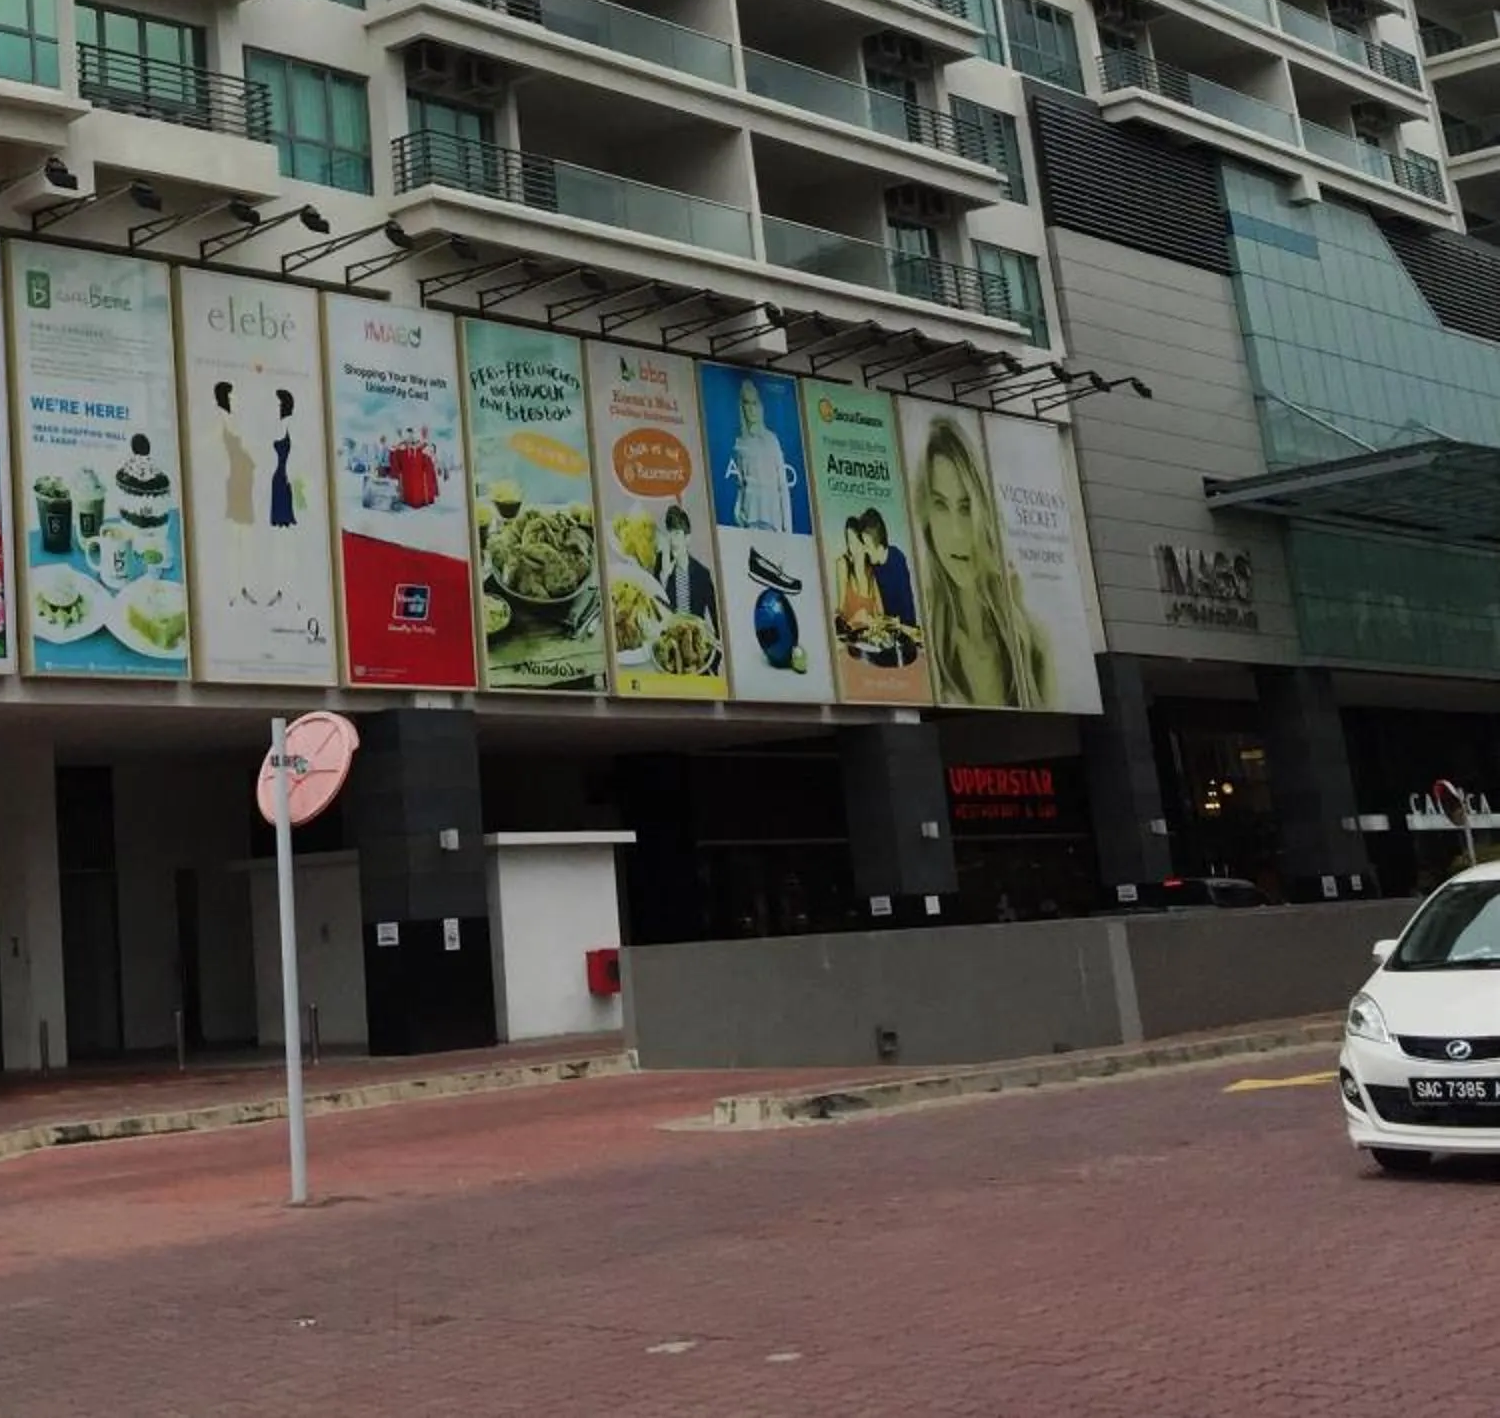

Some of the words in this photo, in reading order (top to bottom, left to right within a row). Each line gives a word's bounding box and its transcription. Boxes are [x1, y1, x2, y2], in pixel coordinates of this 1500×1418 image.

[30, 394, 80, 415] WE'RE
[84, 401, 130, 420] HERE!
[948, 767, 1055, 796] UPPERSTAR
[1415, 1080, 1443, 1098] SAC
[1445, 1080, 1487, 1099] 7385
